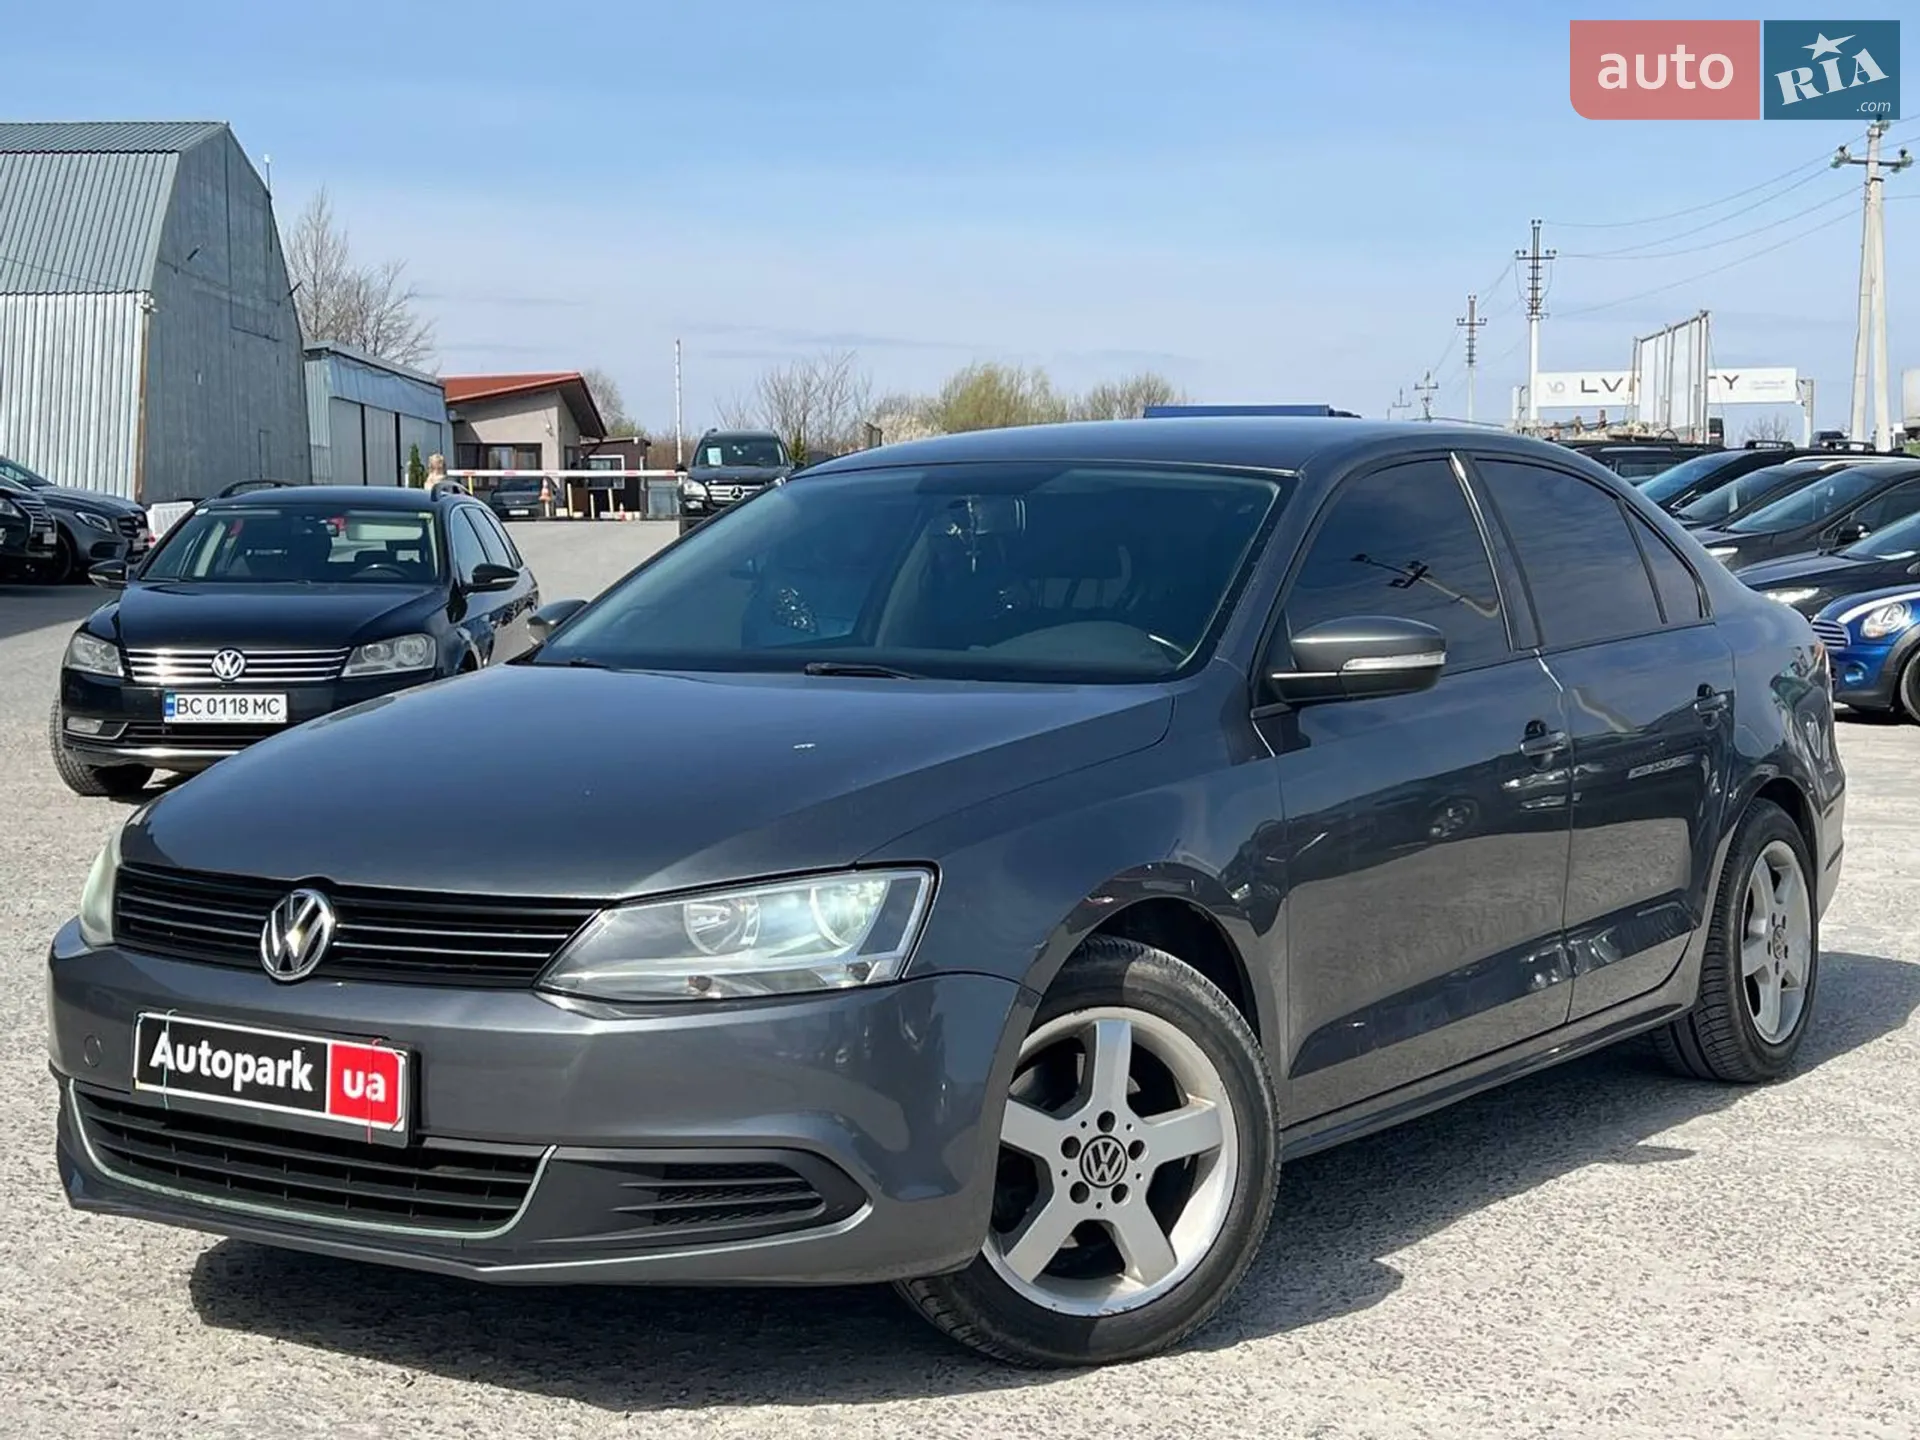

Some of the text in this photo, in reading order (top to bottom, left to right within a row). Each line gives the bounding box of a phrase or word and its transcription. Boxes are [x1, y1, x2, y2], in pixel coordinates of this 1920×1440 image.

[176, 697, 280, 715] BC 0118 MC
[149, 1030, 386, 1103] Autopark ua
